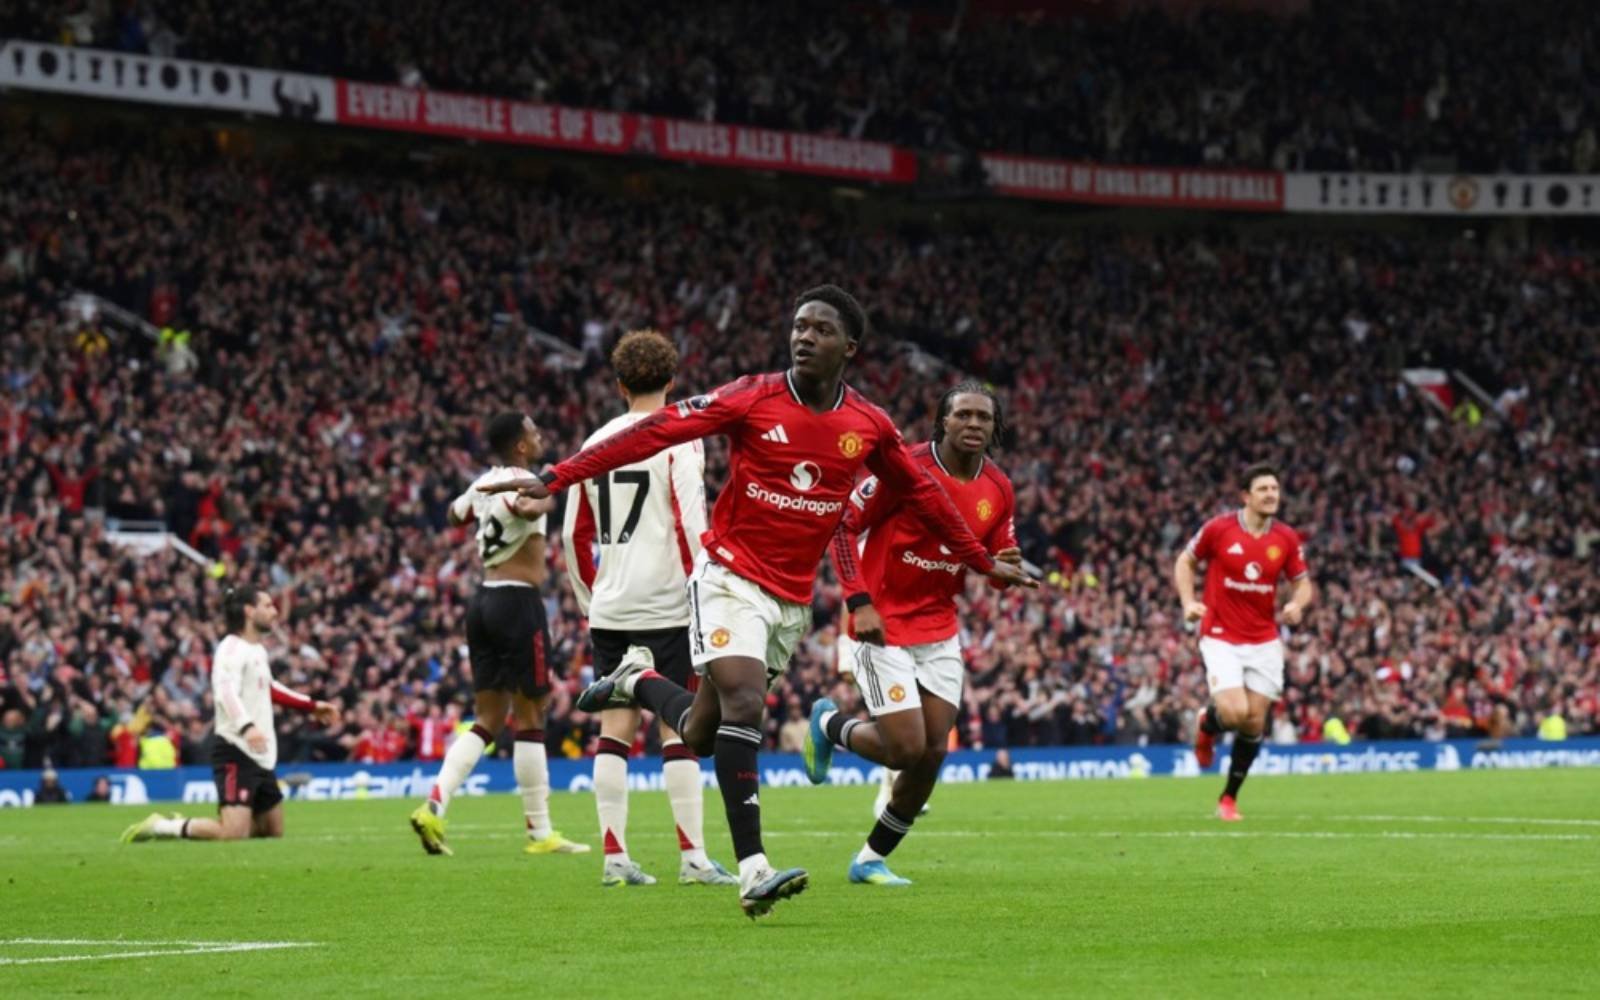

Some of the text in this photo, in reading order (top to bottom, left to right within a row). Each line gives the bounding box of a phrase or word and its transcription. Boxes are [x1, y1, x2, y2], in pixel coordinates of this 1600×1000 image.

[346, 80, 622, 146] EVERY SINGLE ONE OF US
[664, 120, 893, 173] LOVES ALEX FERGUSON
[1071, 166, 1091, 193] OF
[1095, 168, 1173, 198] ENGLISH
[1178, 171, 1278, 203] FOOTBALL
[592, 470, 650, 545] 17
[745, 482, 842, 516] Snapdragon
